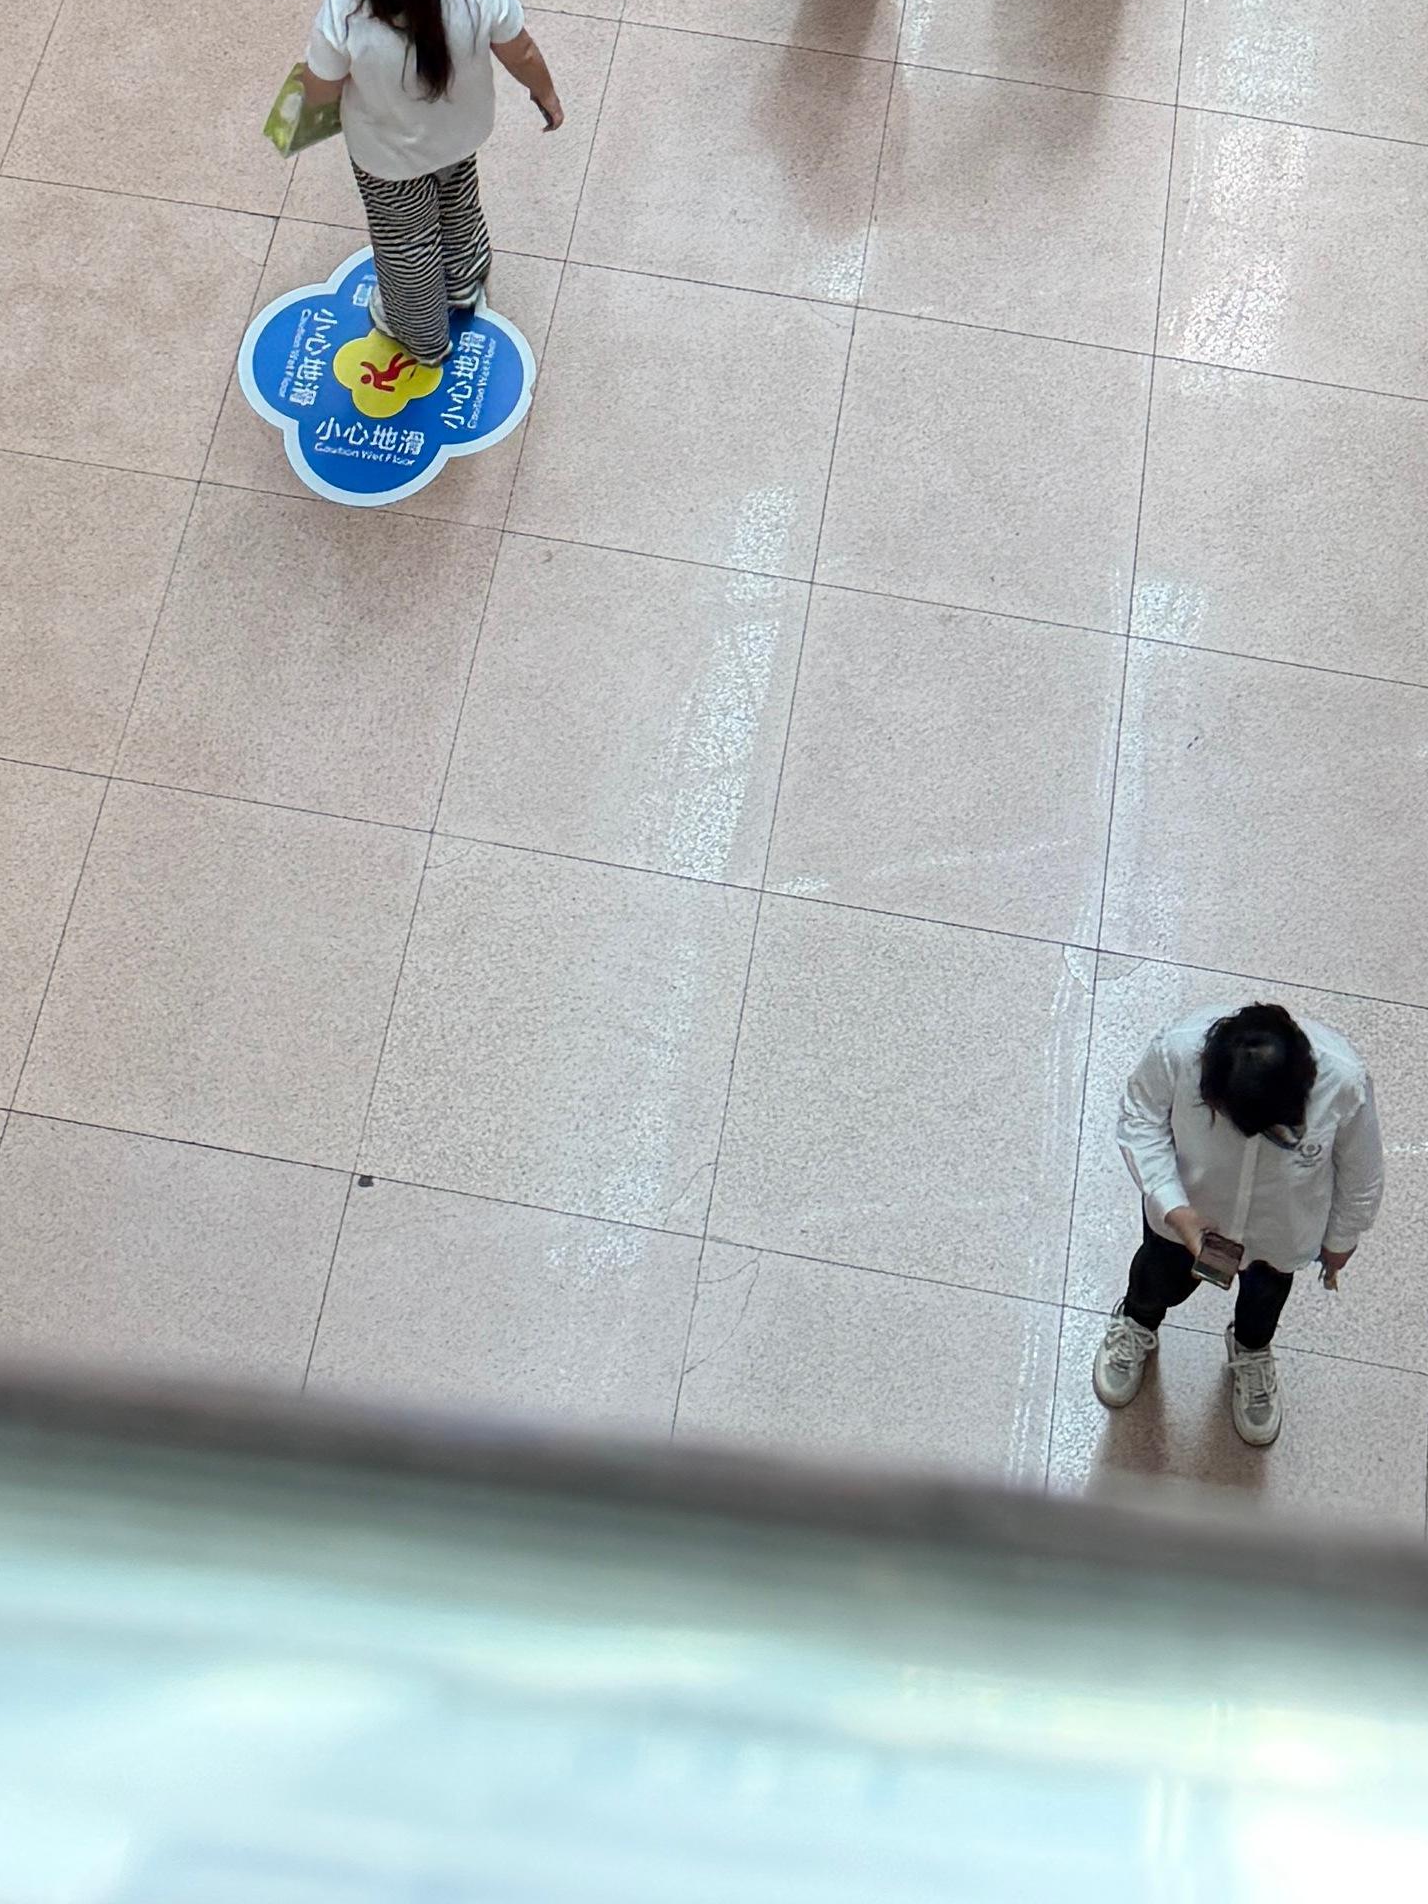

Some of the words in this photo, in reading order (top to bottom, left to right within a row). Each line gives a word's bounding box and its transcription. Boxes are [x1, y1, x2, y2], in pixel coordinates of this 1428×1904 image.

[289, 309, 337, 406] 小心地滑
[440, 331, 486, 430] 小心地滑
[316, 416, 424, 456] 小心地滑
